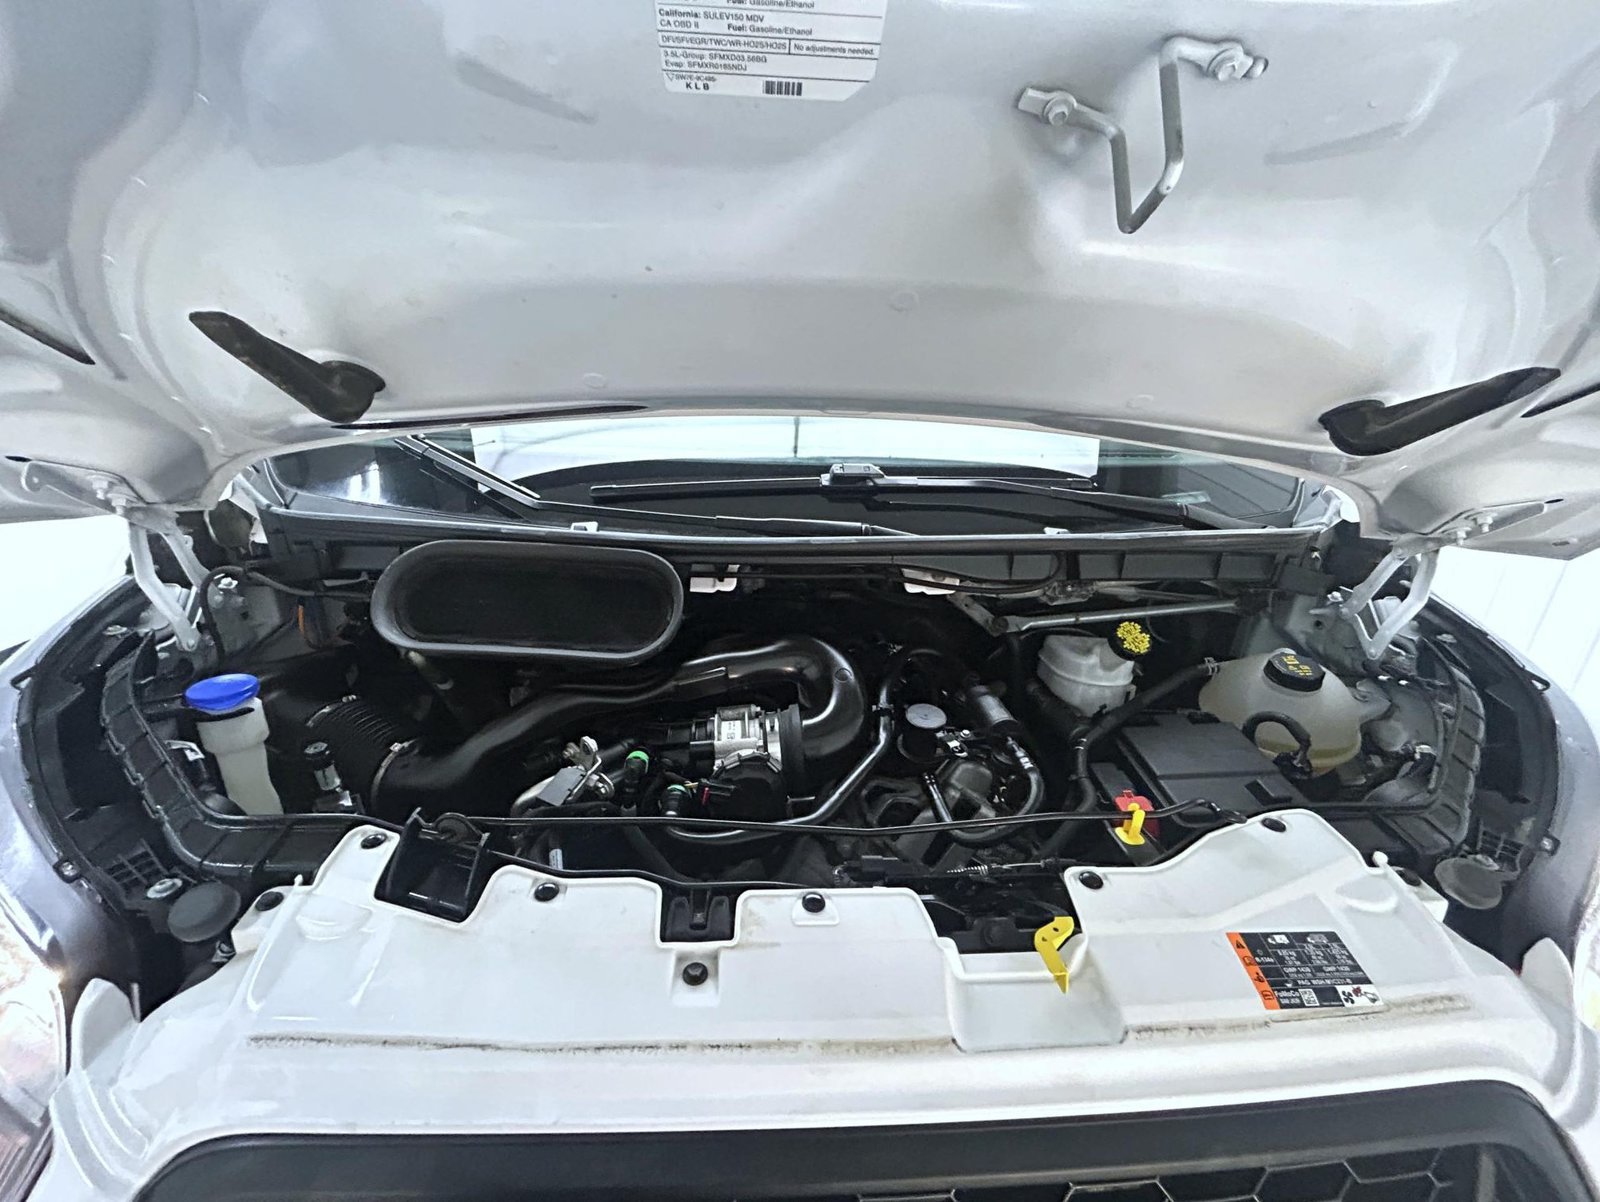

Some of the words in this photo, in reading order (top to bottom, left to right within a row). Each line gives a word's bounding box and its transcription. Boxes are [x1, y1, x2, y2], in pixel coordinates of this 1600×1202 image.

[658, 8, 701, 18] California:
[745, 14, 765, 23] MDV
[660, 19, 671, 27] CA
[674, 20, 691, 28] OBD
[727, 23, 747, 32] Fuel:
[749, 25, 813, 36] Gasoline/Ethanol
[793, 43, 804, 51] No
[805, 45, 846, 54] adjustments
